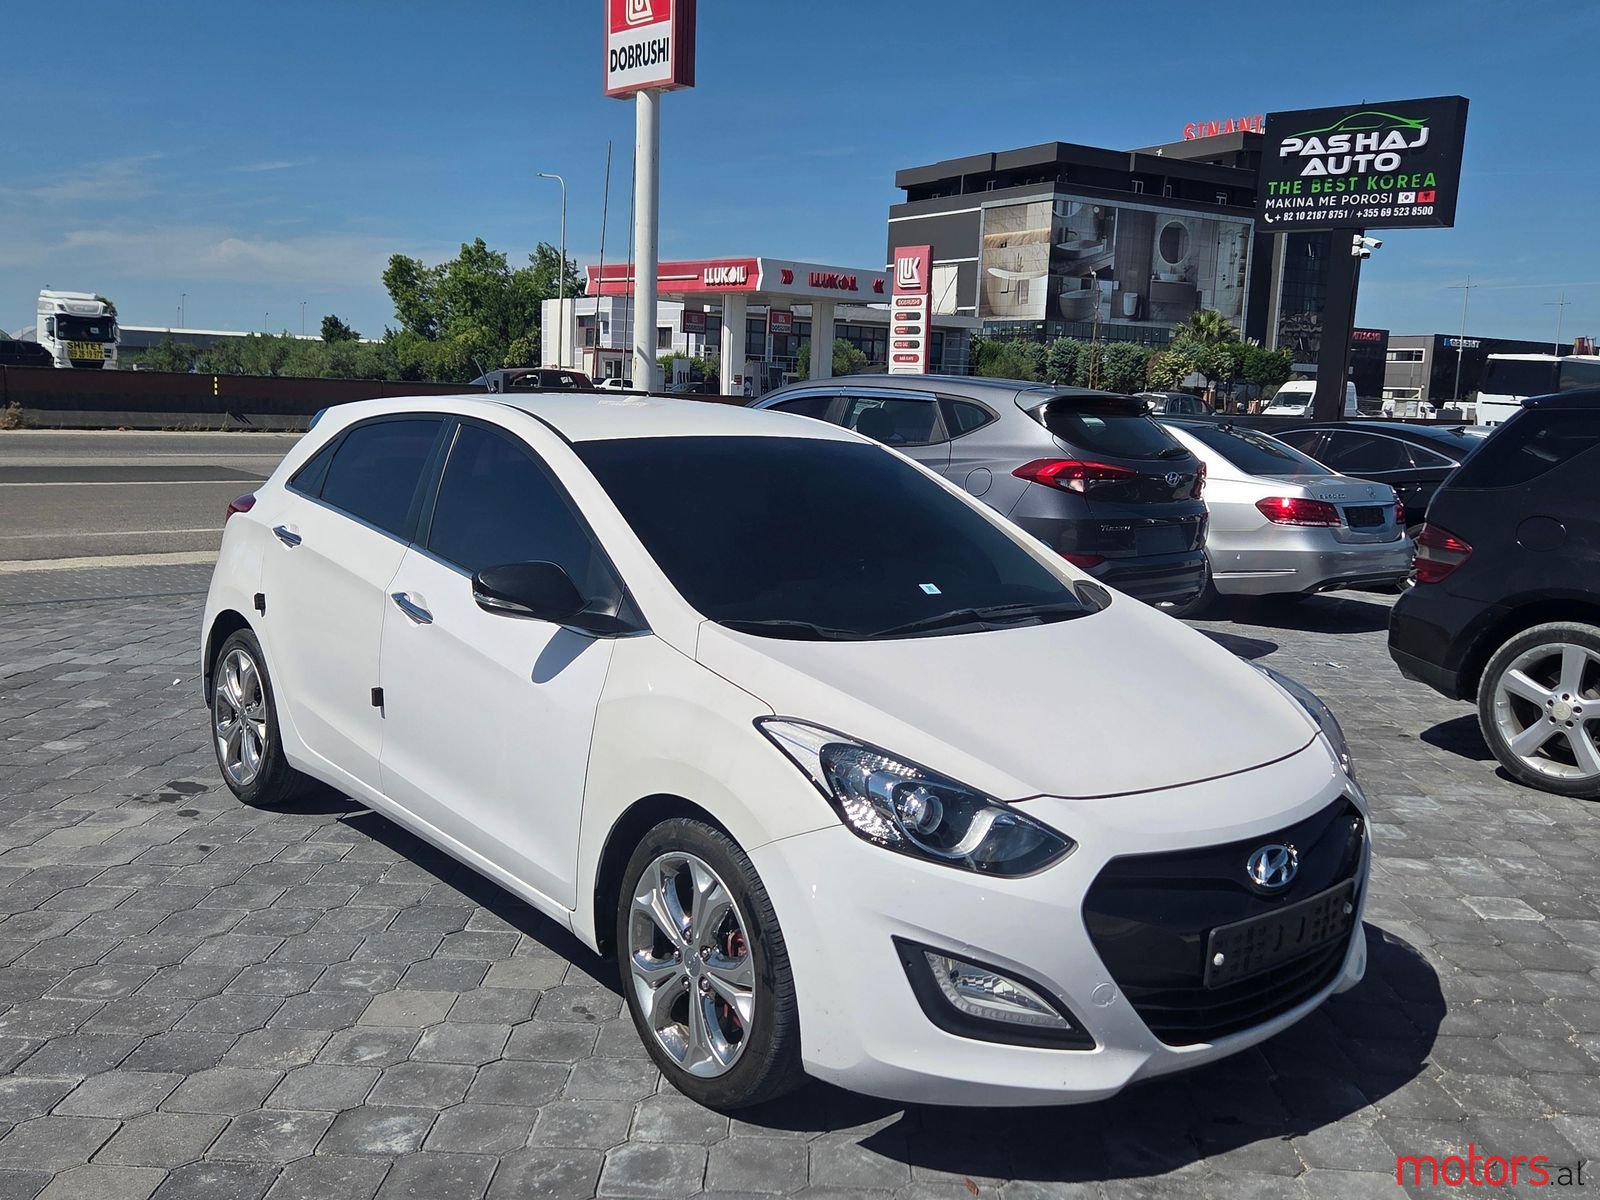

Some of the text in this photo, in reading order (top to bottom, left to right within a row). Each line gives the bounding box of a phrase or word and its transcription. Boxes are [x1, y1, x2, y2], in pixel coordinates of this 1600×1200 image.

[610, 37, 669, 73] DOBRUSHI
[1280, 127, 1429, 157] PASHAJ
[1300, 152, 1402, 176] AUTO
[1268, 172, 1436, 195] THE BEST KOREA
[1265, 192, 1392, 209] MAKINA ME POROSI
[1283, 212, 1293, 221] 82
[1295, 211, 1305, 220] 10
[1306, 210, 1327, 220] 2187
[1328, 210, 1348, 219] 8751
[1356, 208, 1379, 218] +355
[1380, 207, 1391, 217] 69
[1393, 206, 1410, 217] 523
[1411, 206, 1434, 216] 8500
